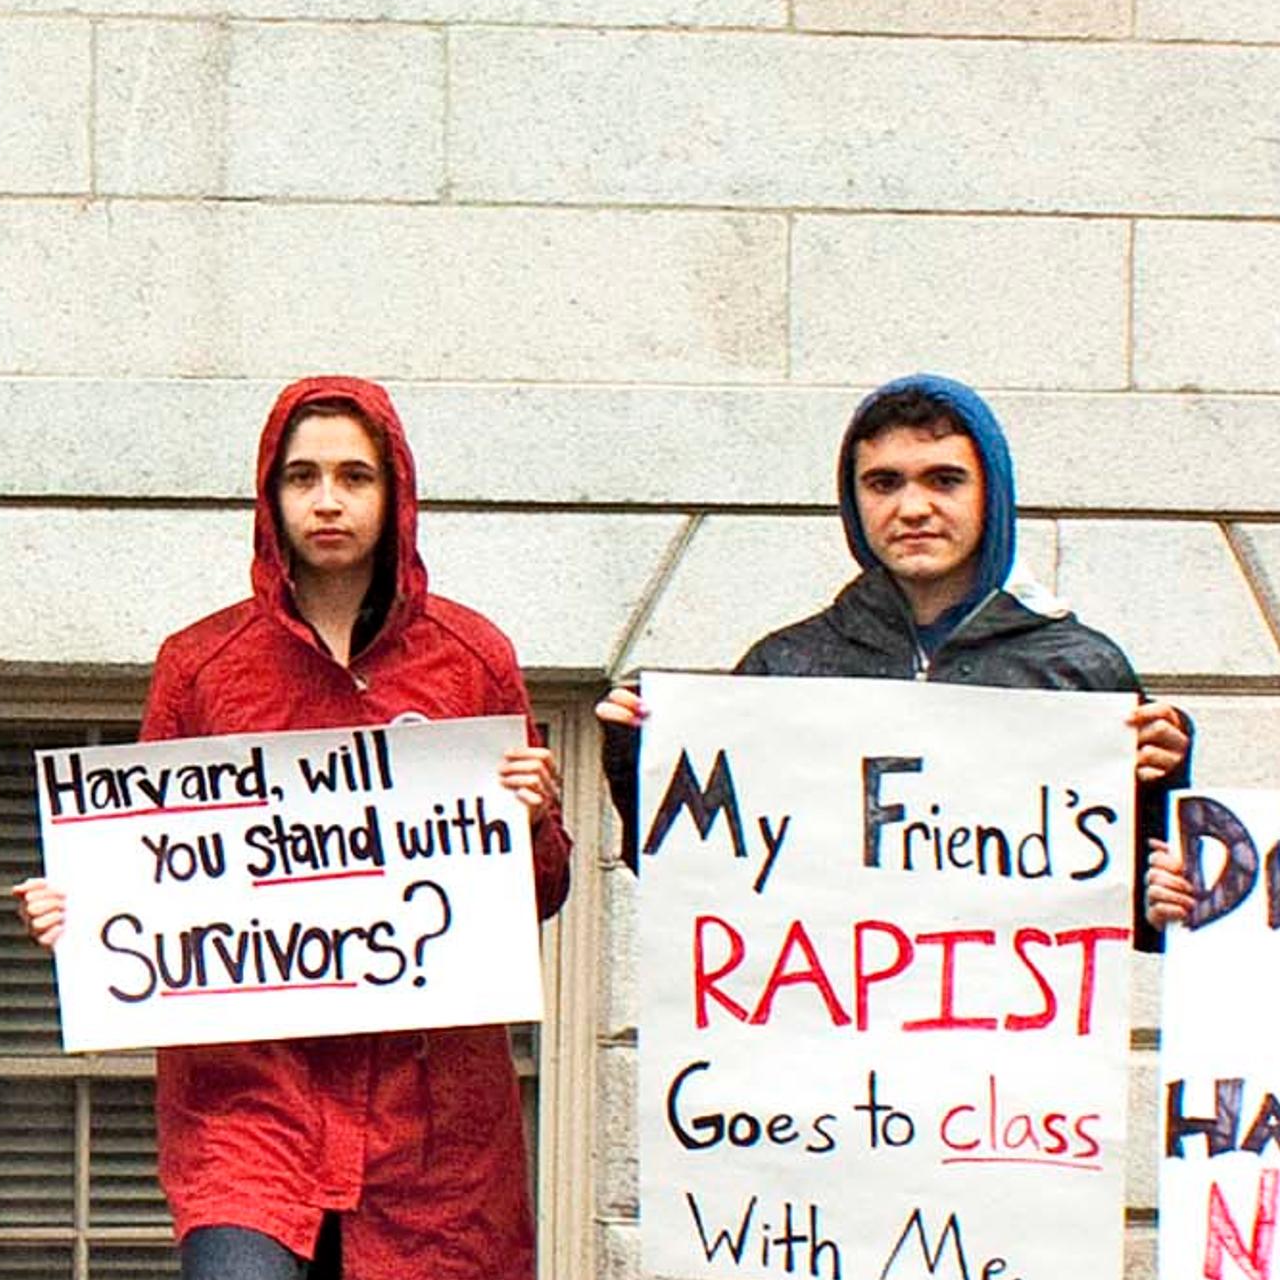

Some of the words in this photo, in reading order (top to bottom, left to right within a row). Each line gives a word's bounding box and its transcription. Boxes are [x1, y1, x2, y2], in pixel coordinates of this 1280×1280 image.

[42, 746, 285, 817] Harvard,
[298, 729, 394, 794] will
[396, 797, 511, 859] with
[643, 748, 791, 894] My
[1177, 796, 1280, 932] D
[100, 880, 453, 1003] Survivors?
[693, 915, 1131, 1036] RAPIST
[666, 1062, 838, 1155] Goes
[854, 1070, 916, 1149] to
[940, 1074, 1101, 1158] class
